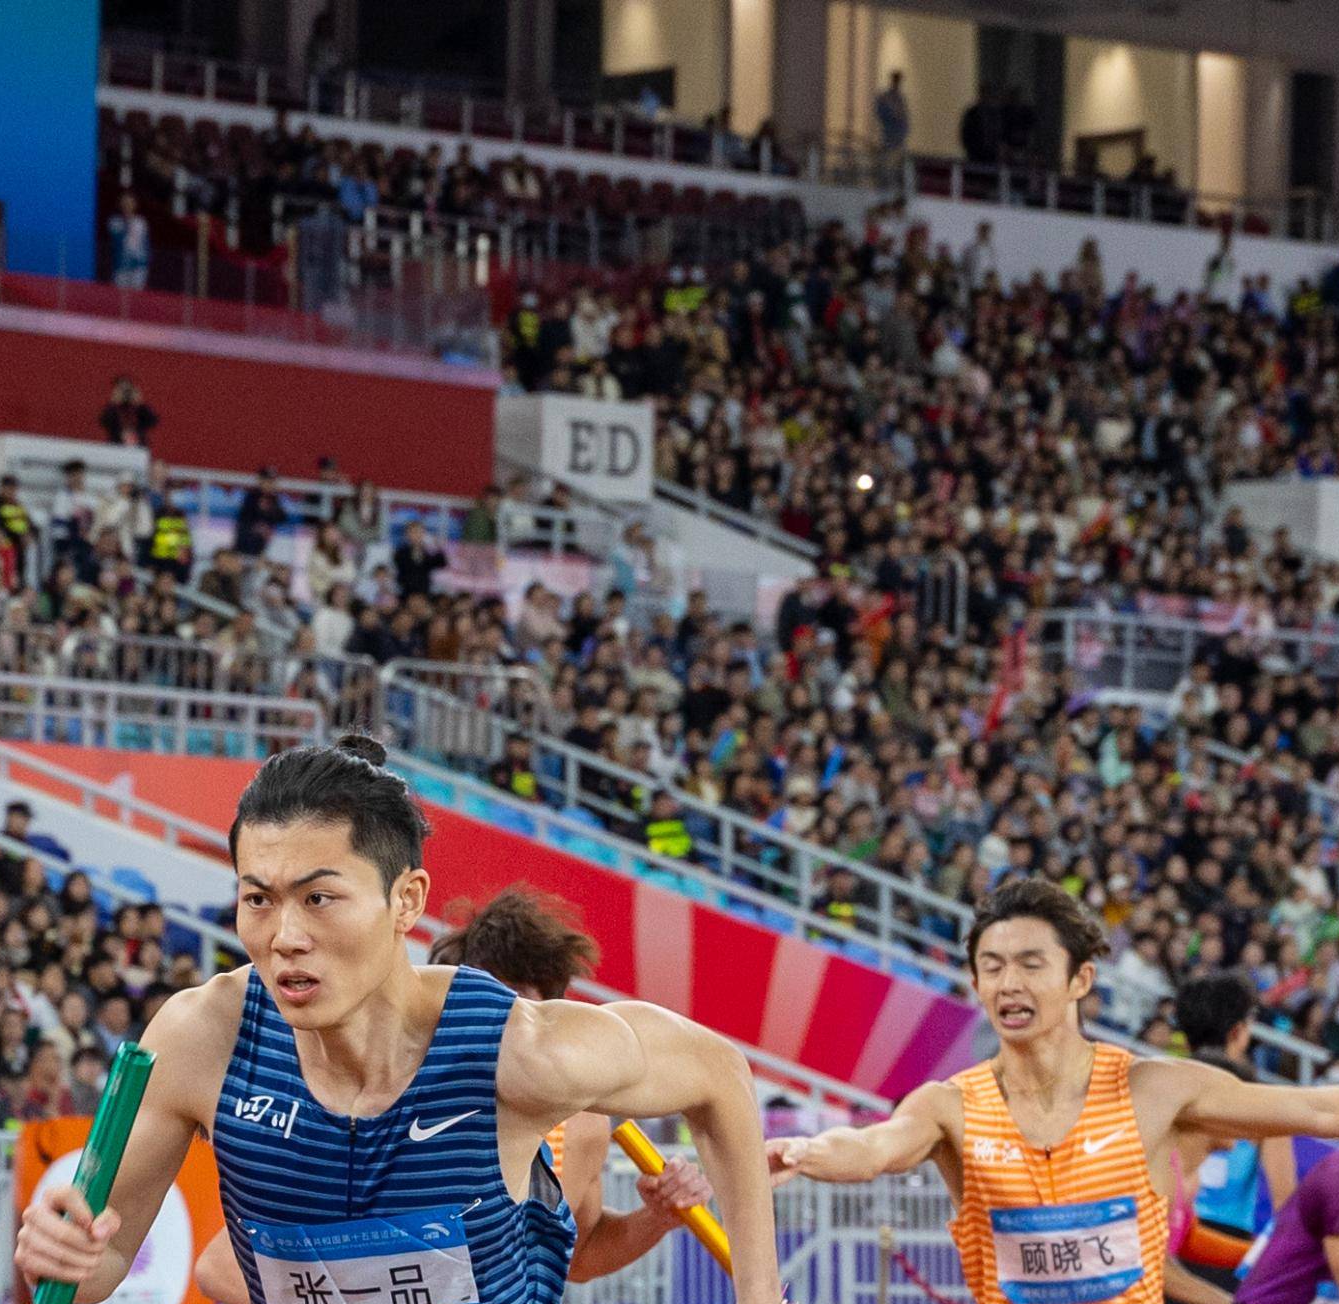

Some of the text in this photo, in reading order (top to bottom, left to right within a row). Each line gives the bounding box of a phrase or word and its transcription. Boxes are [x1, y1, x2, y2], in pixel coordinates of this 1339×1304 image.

[568, 420, 640, 477] ED
[235, 1095, 300, 1139] 四川
[1019, 1235, 1115, 1275] 顾晓飞
